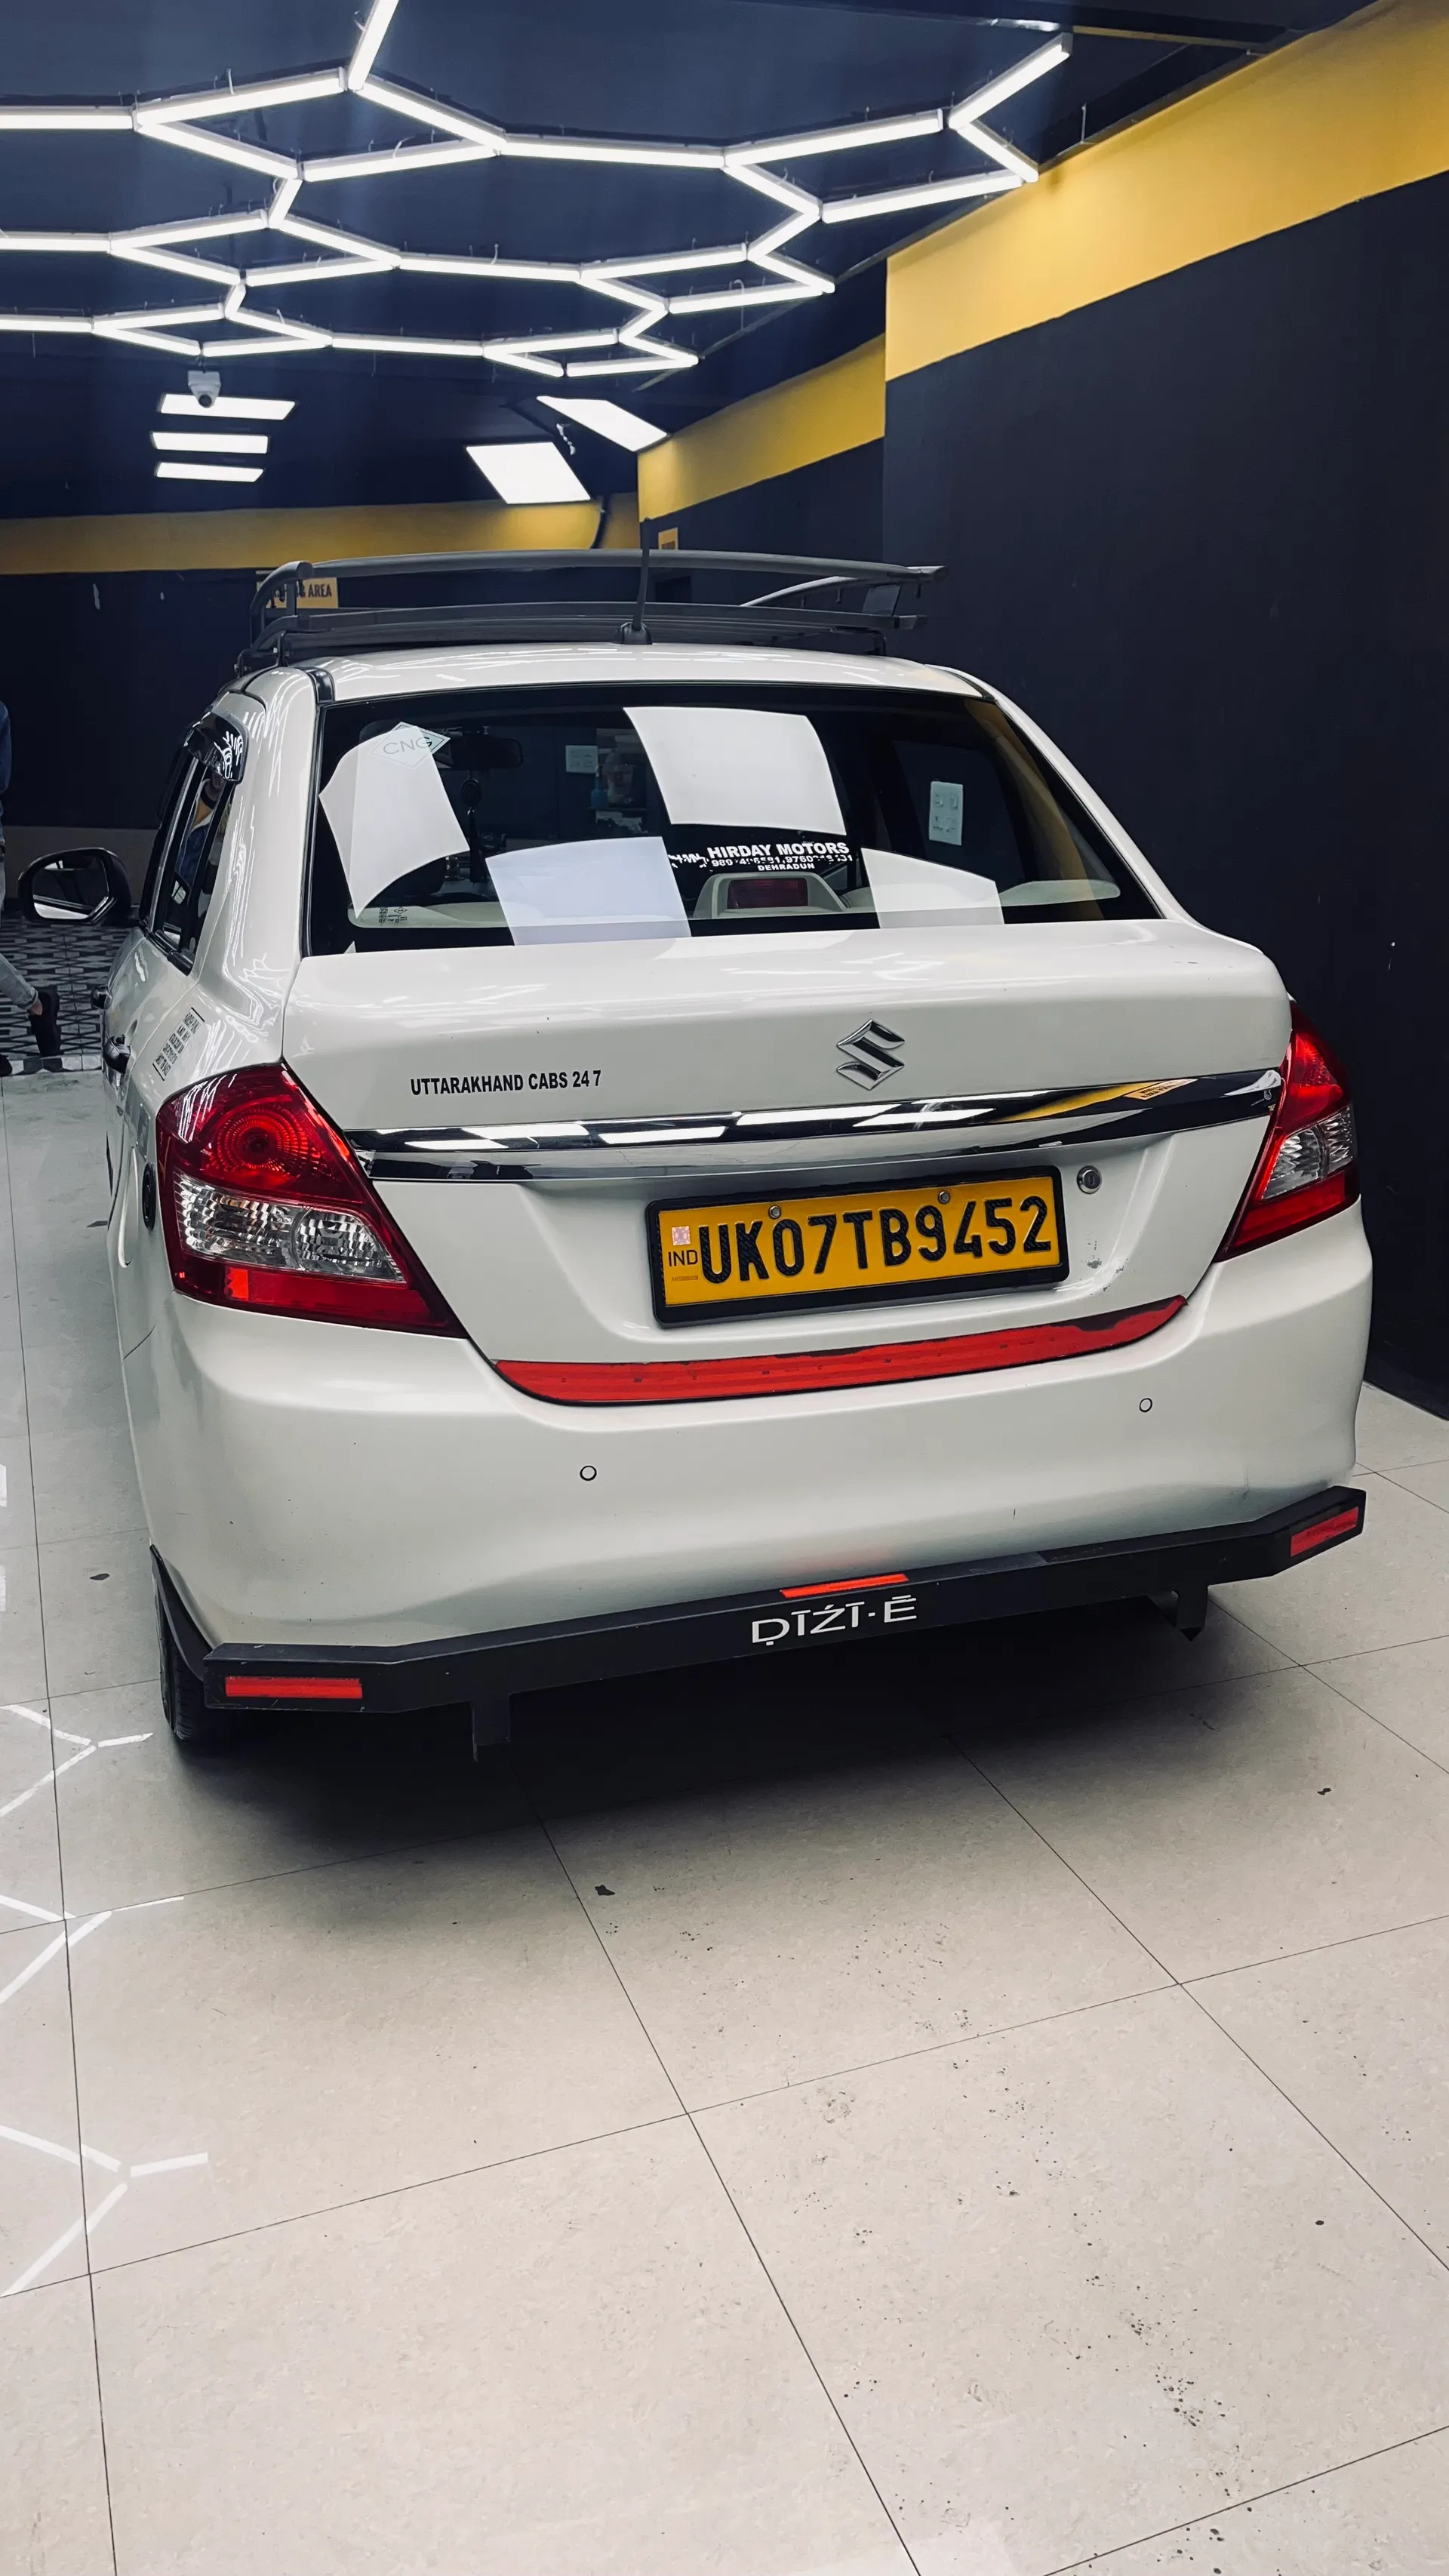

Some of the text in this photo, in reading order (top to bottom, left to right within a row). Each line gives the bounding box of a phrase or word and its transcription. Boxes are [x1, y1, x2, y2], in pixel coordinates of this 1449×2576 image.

[308, 583, 332, 598] AREA
[383, 737, 433, 755] CNG
[707, 842, 850, 859] HIRDAY MOTORS
[757, 863, 816, 871] DEHRADUN
[410, 1074, 524, 1096] UTTARAKHAND
[528, 1072, 568, 1090] CABS
[698, 1195, 1052, 1285] UK07TB9452
[667, 1249, 699, 1267] IND
